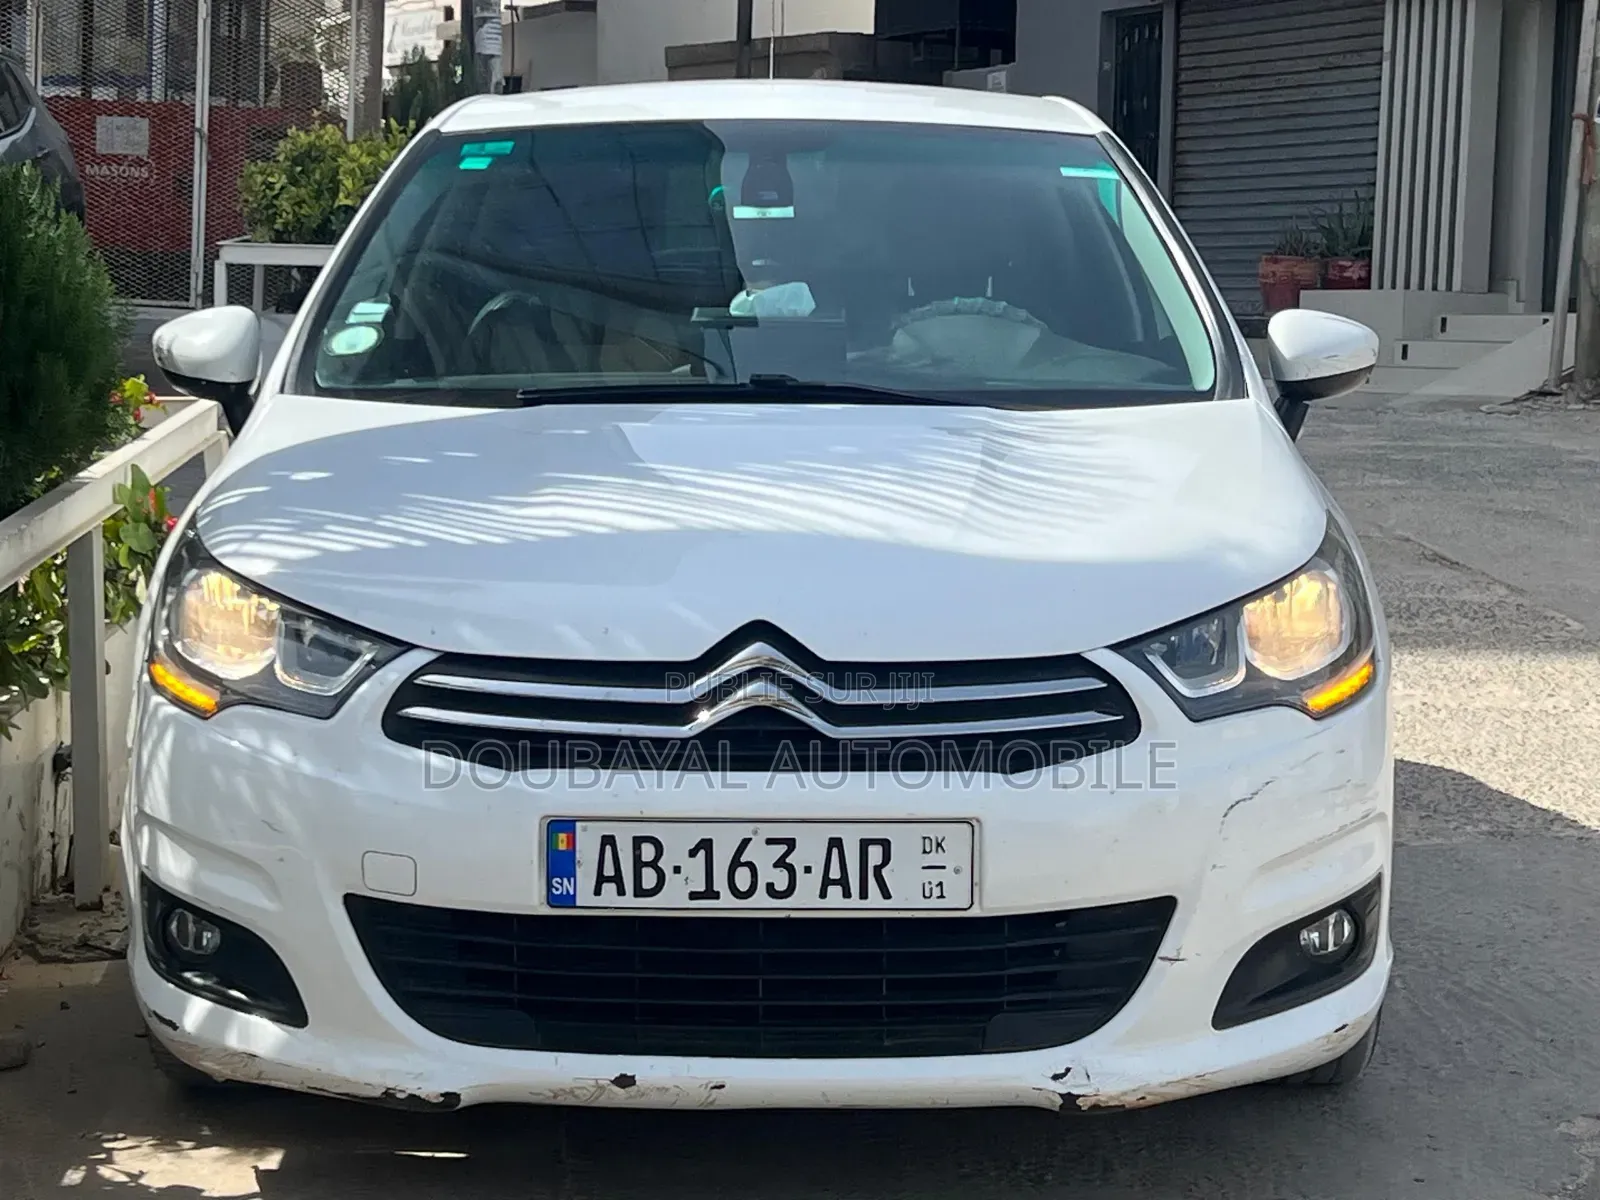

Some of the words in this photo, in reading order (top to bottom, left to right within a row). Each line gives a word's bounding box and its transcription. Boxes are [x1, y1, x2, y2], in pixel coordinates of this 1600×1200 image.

[921, 836, 946, 854] DK
[551, 877, 575, 896] SN
[922, 880, 946, 899] 01
